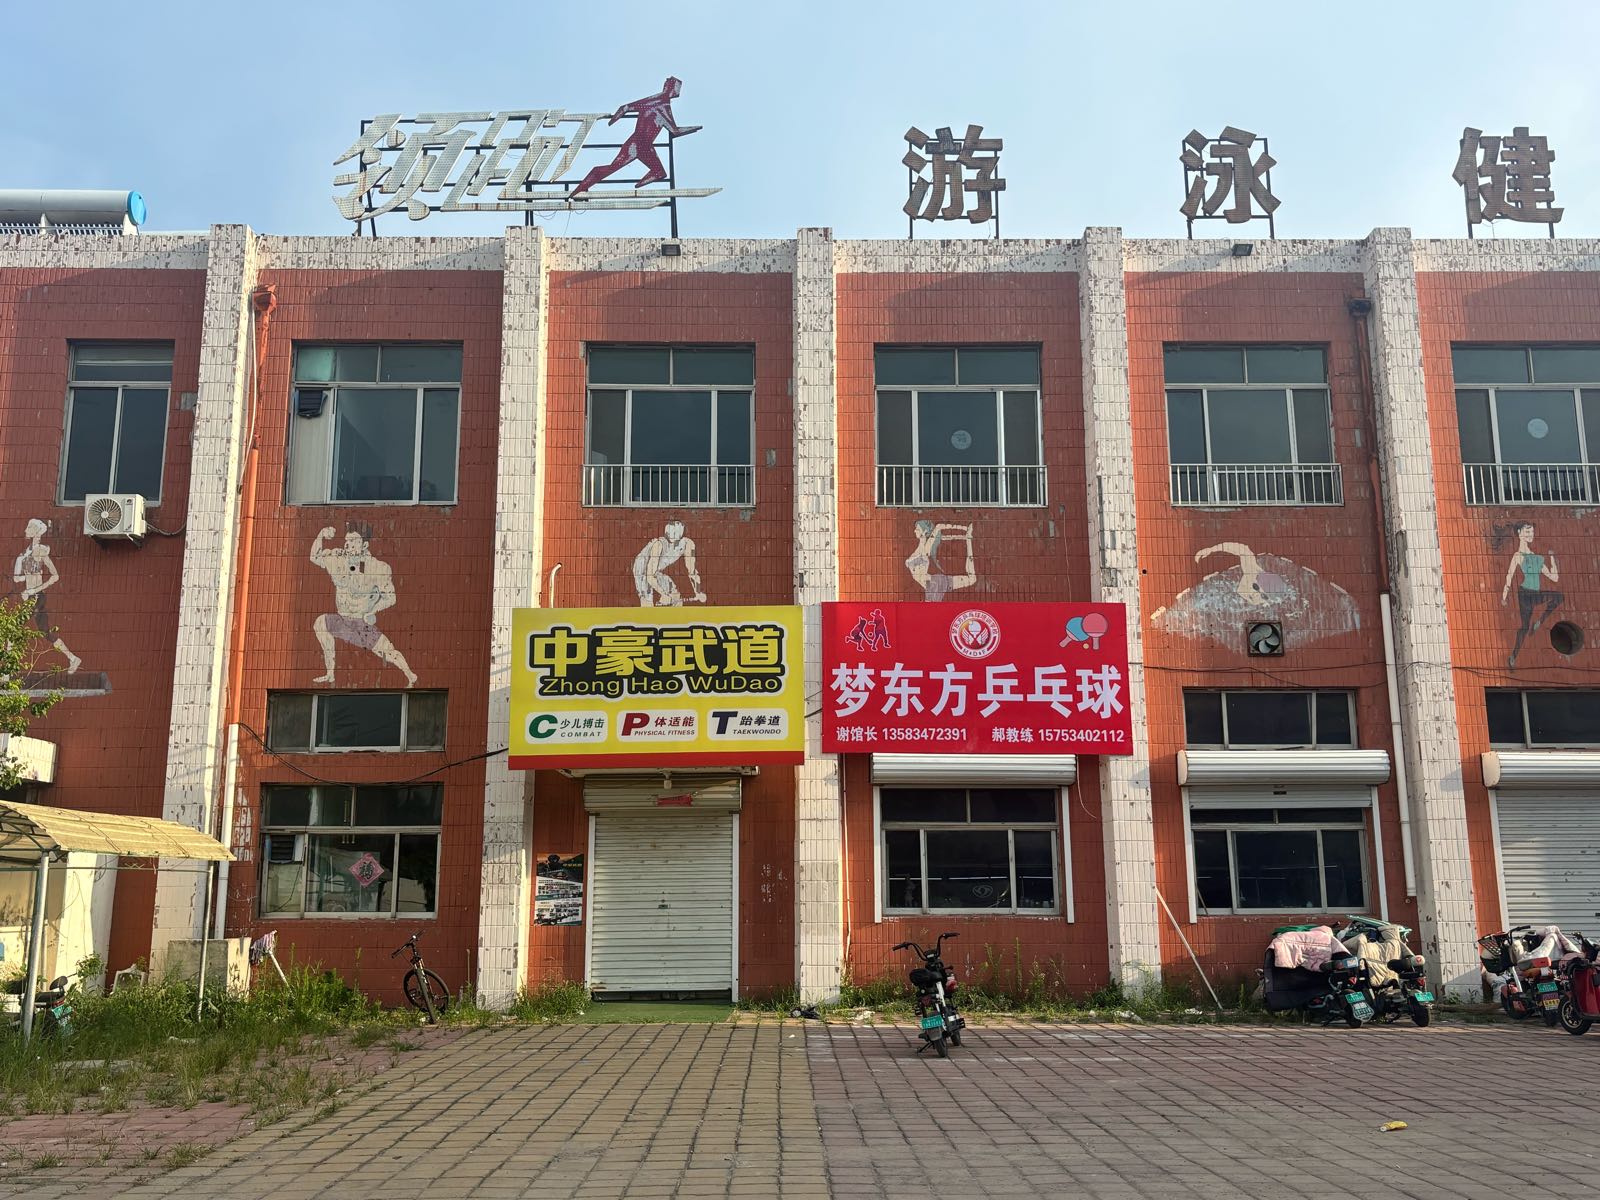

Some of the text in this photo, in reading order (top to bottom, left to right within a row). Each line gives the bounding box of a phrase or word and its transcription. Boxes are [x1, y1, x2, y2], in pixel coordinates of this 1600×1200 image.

[902, 124, 1565, 224] 游 泳 健
[532, 627, 783, 677] 中豪武道
[542, 676, 778, 694] Zhong Hao WuDao
[830, 662, 1124, 719] 梦东方乒乓球
[528, 714, 558, 739] C
[560, 718, 605, 729] 少儿搏击
[621, 712, 650, 736] P
[654, 716, 696, 727] 体适能
[712, 711, 739, 735] T
[739, 715, 781, 726] 跆拳道
[836, 726, 967, 742] 谢馆长 13583472391
[991, 726, 1125, 743] 郝教练 15753402112
